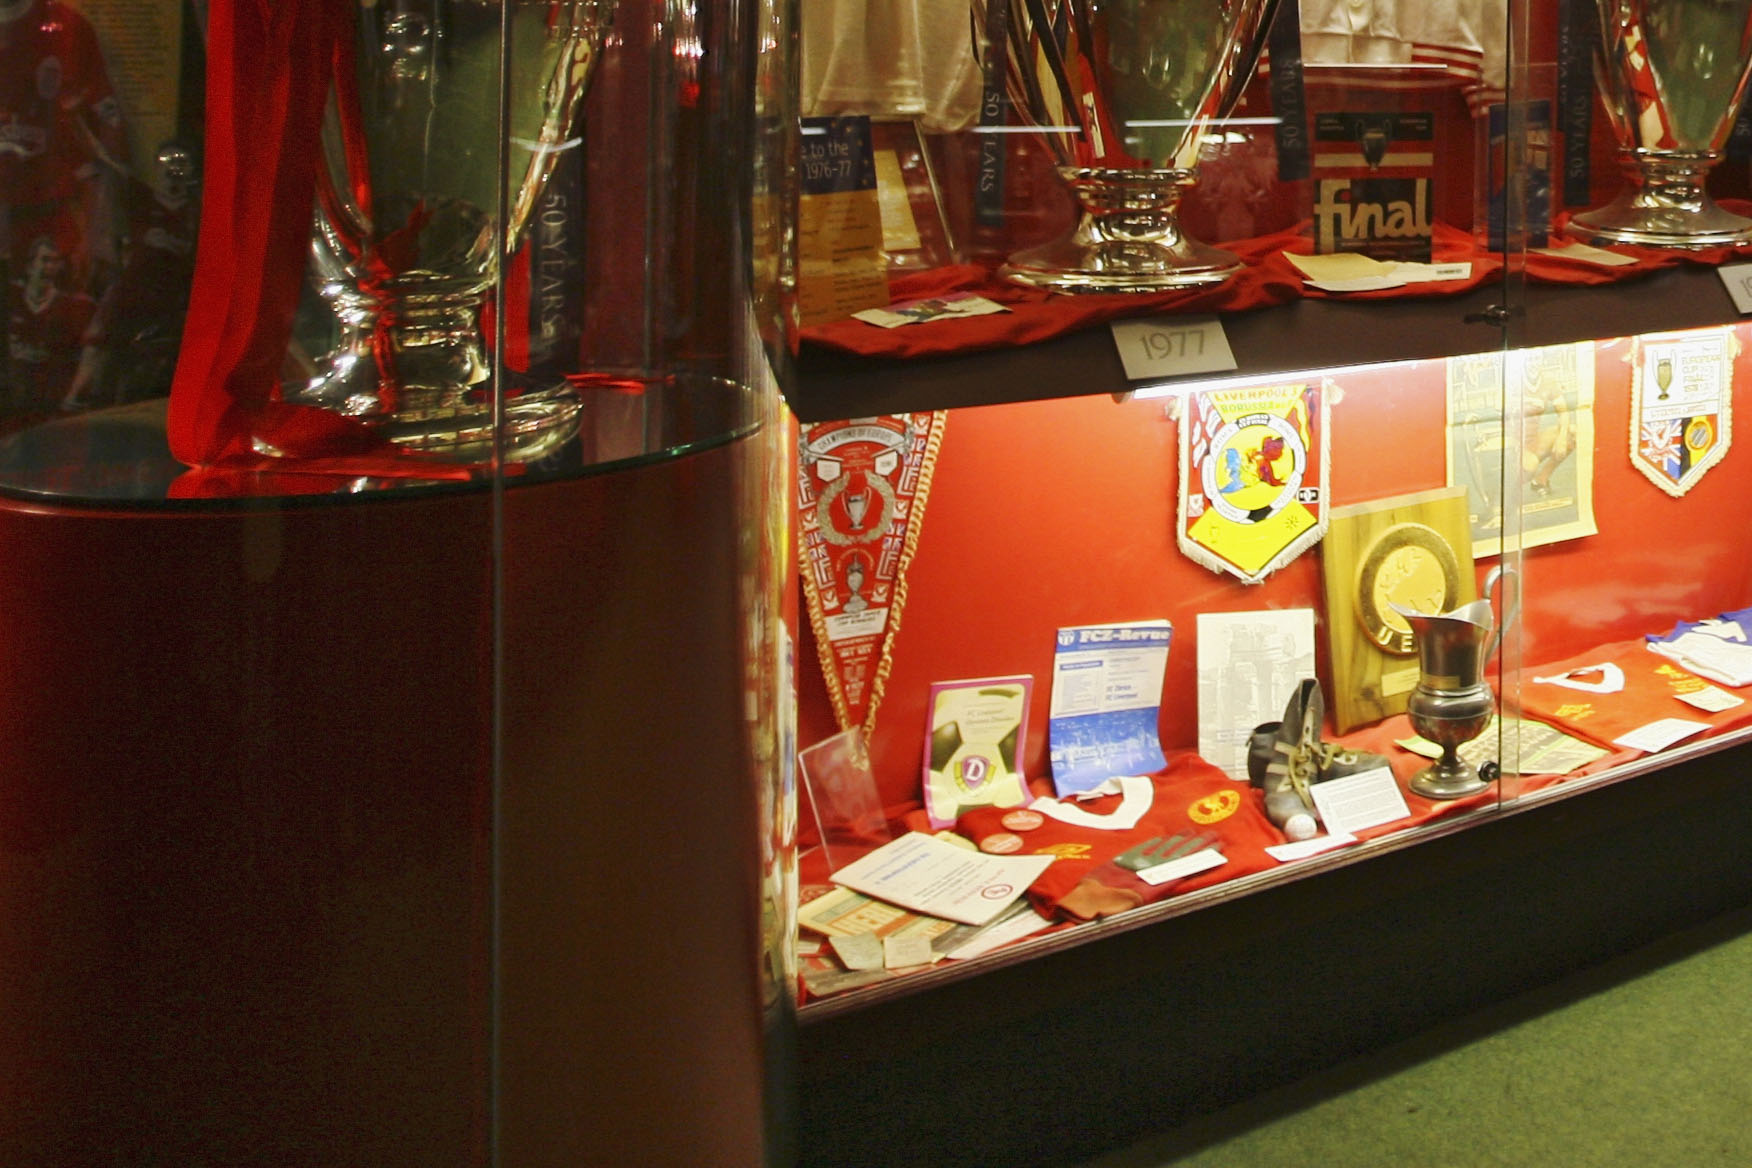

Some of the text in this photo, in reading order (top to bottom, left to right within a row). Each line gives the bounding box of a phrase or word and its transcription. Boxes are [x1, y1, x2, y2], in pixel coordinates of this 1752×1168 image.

[810, 141, 825, 159] to
[828, 139, 849, 157] the
[806, 160, 852, 180] 1976-77
[1313, 178, 1432, 254] final
[1139, 329, 1205, 360] 1977
[965, 757, 985, 781] D
